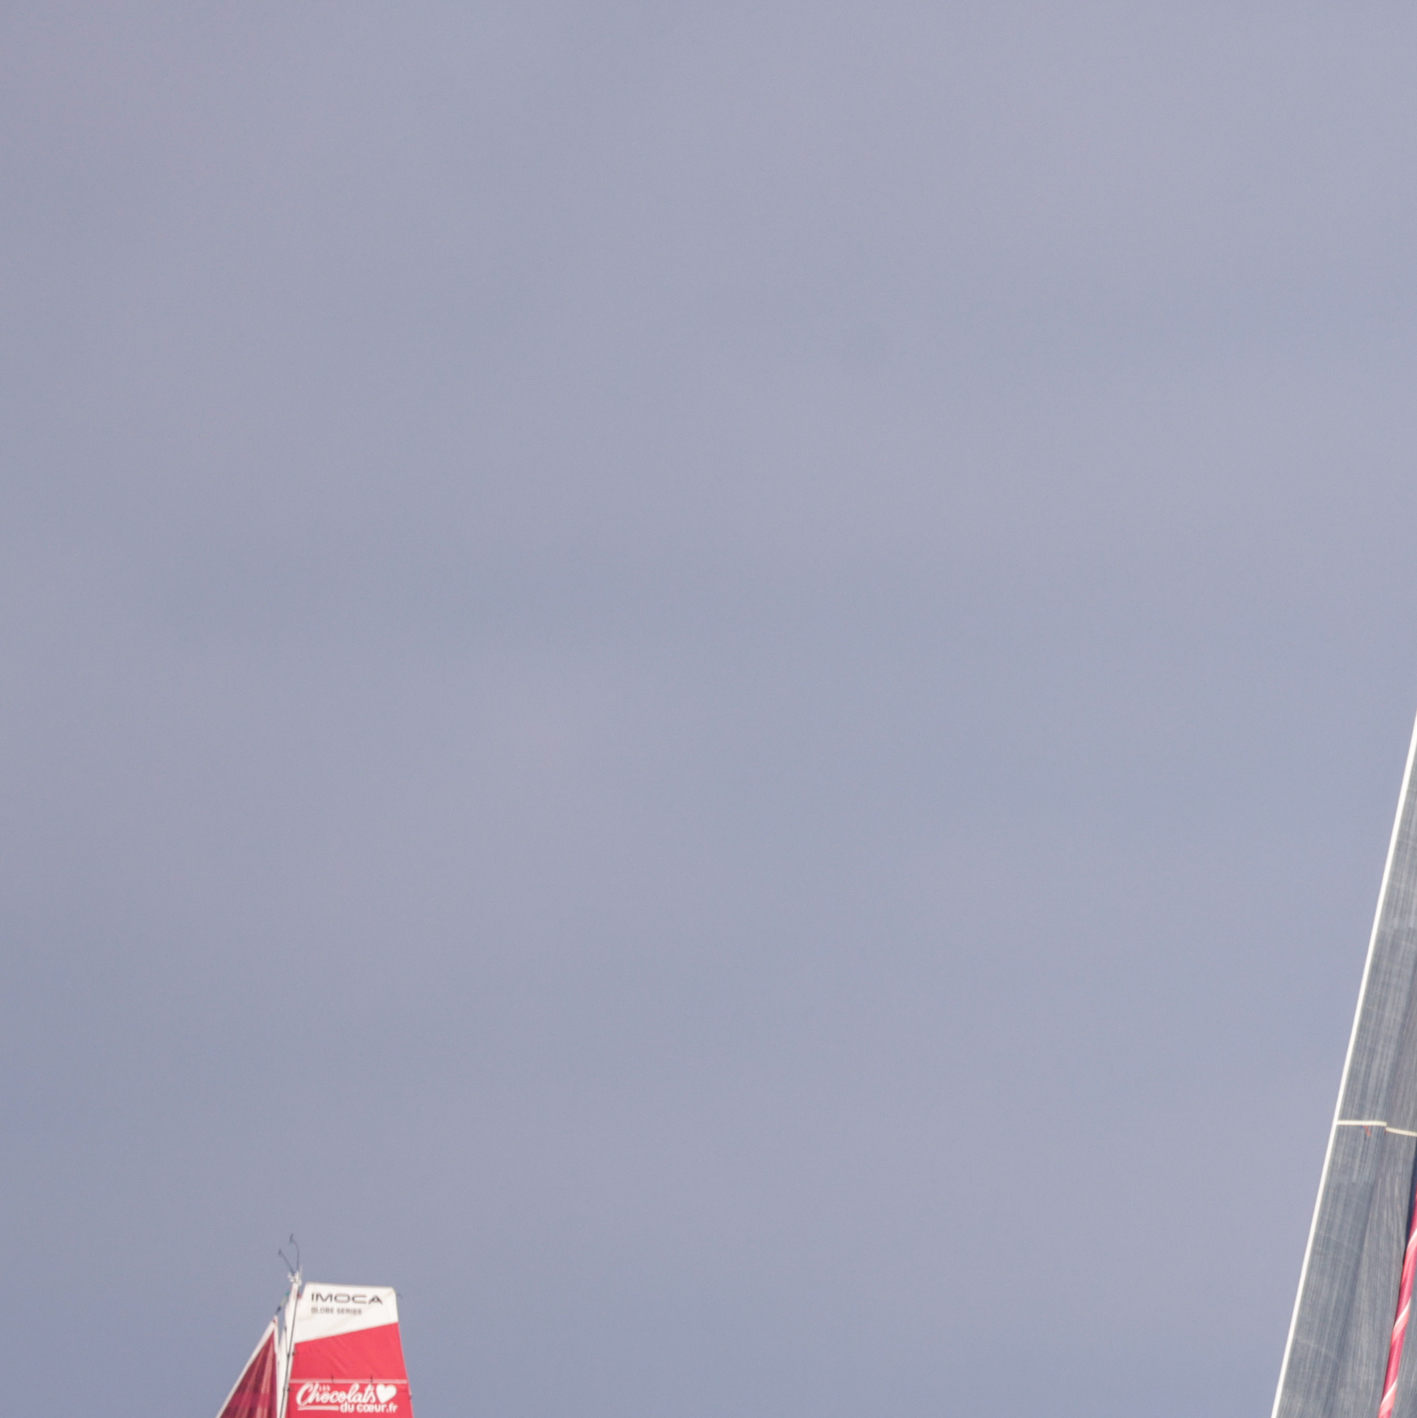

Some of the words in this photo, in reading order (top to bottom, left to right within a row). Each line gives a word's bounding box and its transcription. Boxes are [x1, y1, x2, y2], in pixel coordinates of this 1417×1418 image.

[311, 1292, 384, 1305] IMOCA
[296, 1381, 376, 1407] Chocolats
[340, 1402, 355, 1413] du
